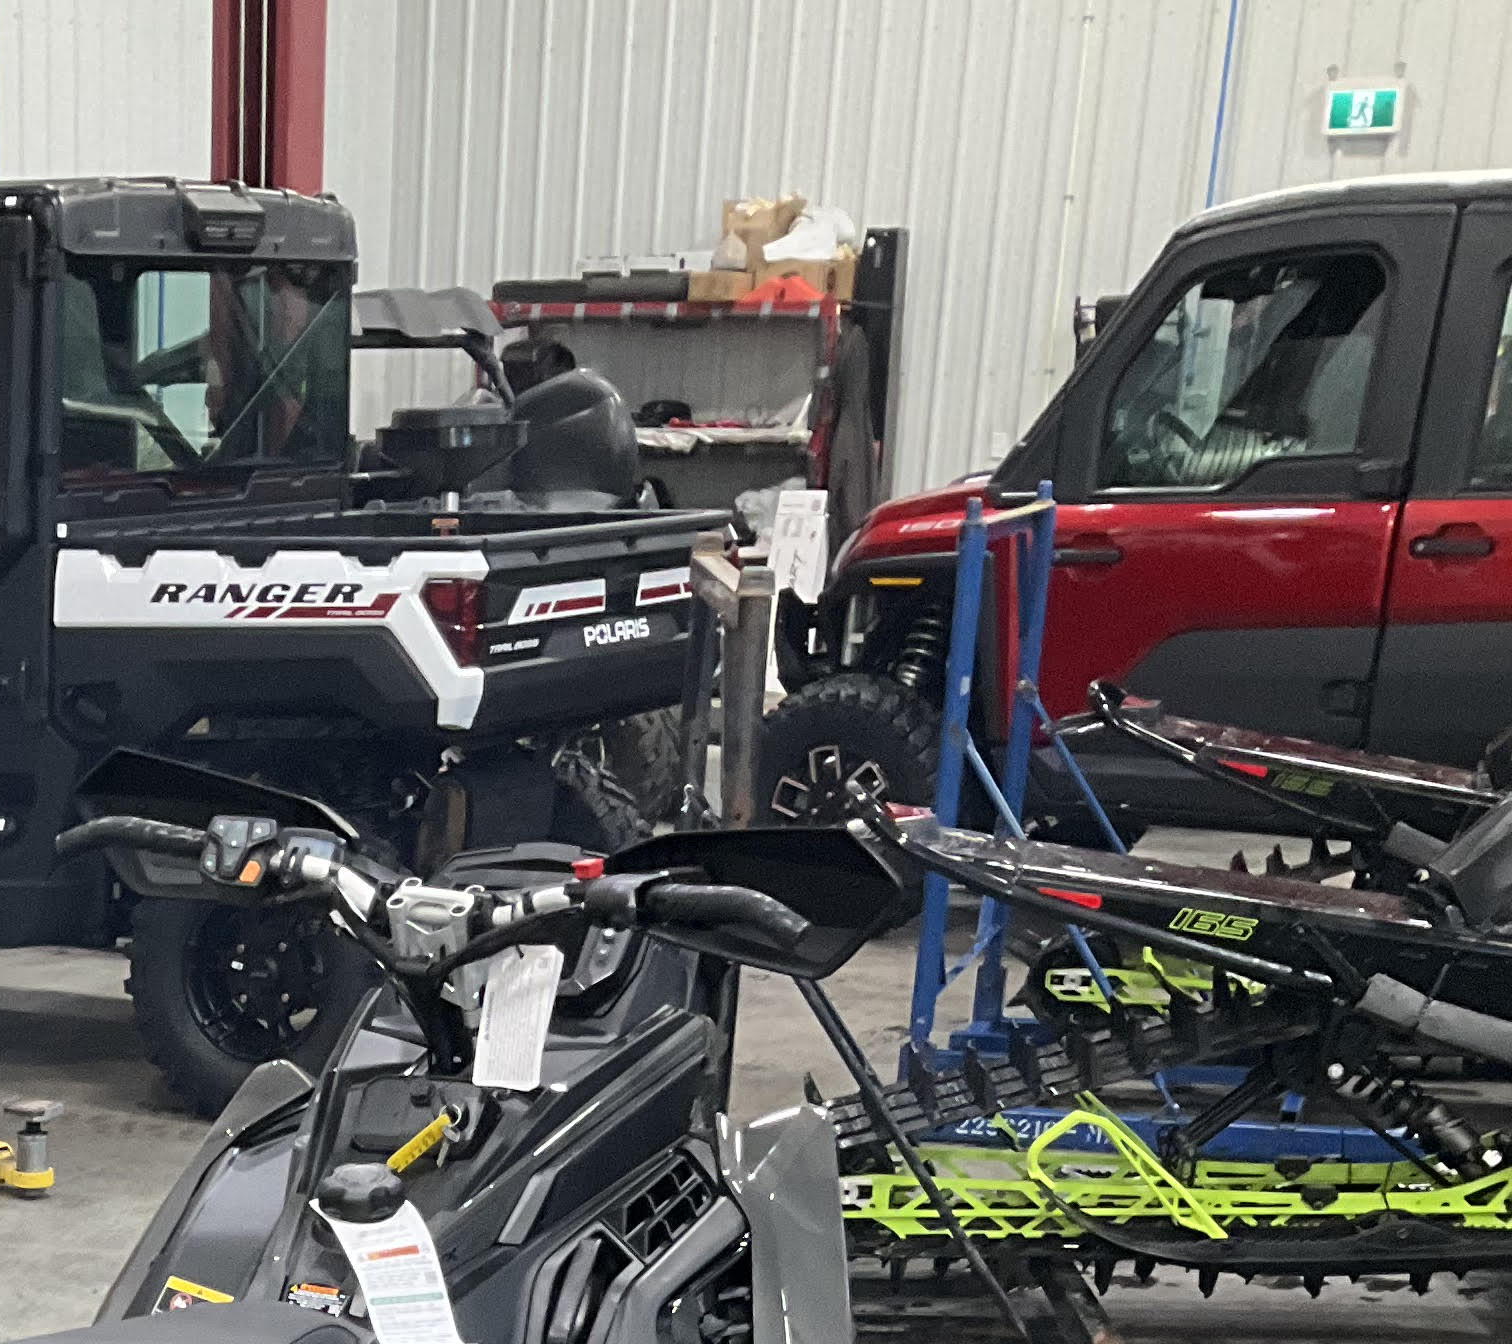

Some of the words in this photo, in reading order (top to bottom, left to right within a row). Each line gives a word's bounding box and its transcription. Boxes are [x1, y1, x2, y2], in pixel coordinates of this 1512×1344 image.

[150, 583, 364, 604] RANGER
[583, 616, 650, 648] POLARIS
[1168, 907, 1260, 941] 165
